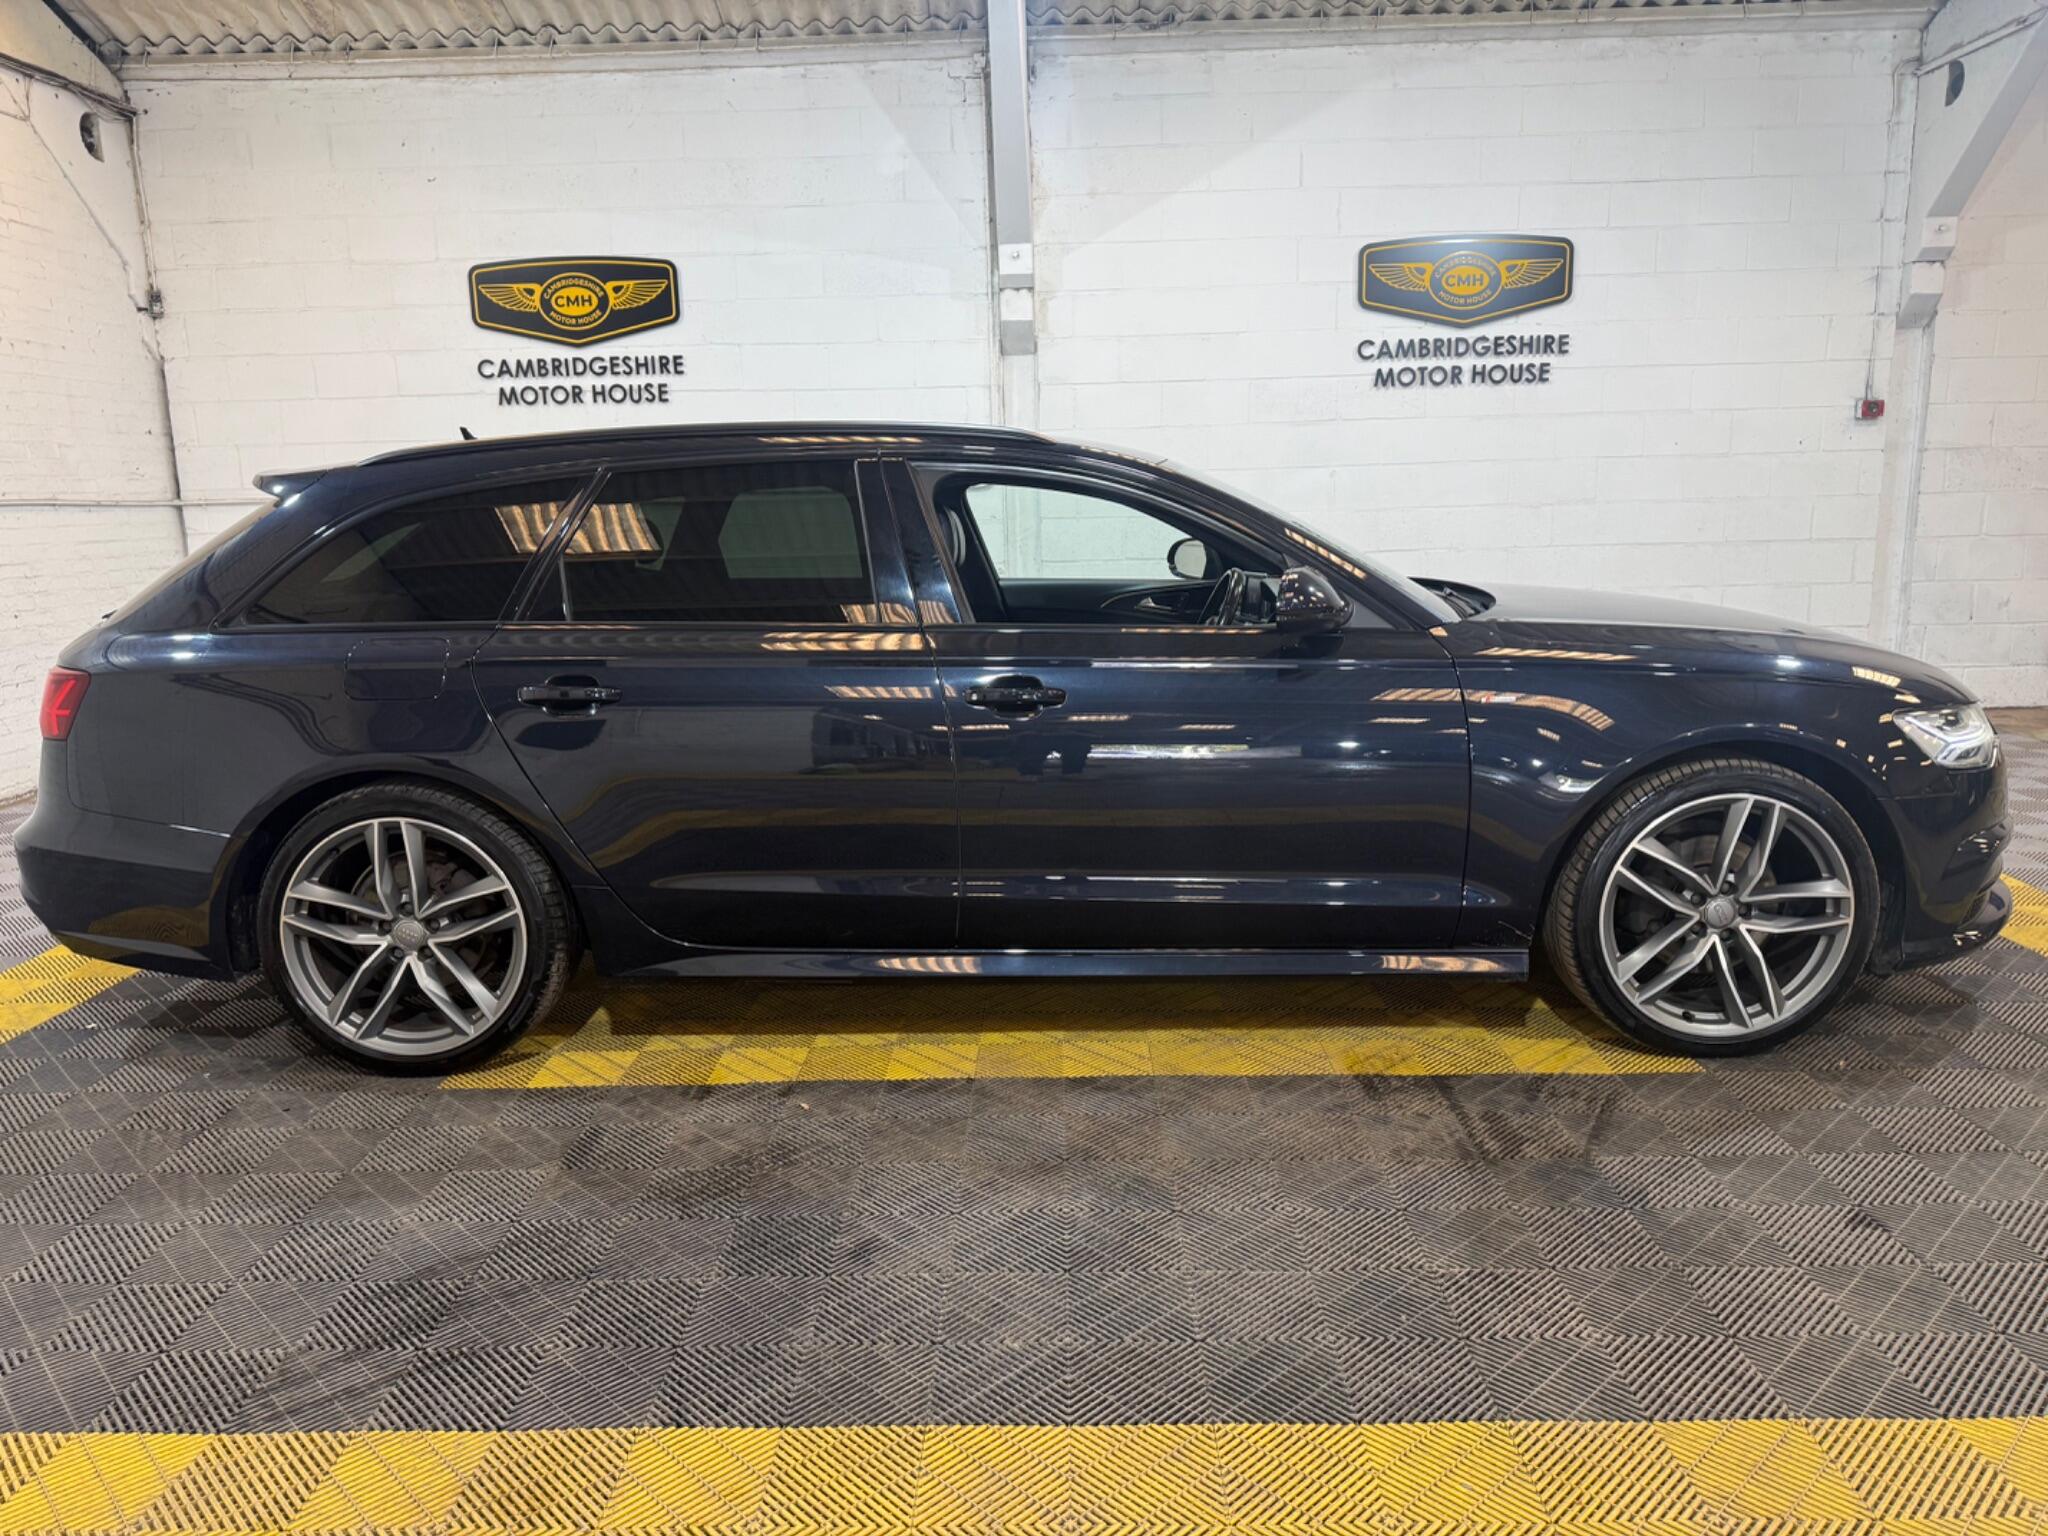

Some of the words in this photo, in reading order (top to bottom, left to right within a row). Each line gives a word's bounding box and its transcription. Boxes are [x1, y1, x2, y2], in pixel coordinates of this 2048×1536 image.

[1444, 273, 1484, 288] CMH
[554, 294, 593, 308] CMH
[550, 311, 577, 325] MOTOR
[577, 309, 602, 324] HOUSE
[1357, 334, 1570, 360] CAMBRIDGESHIRE
[477, 355, 685, 379] CAMBRIDGESHIRE
[1373, 366, 1463, 388] MOTOR
[1471, 363, 1551, 384] HOUSE
[498, 385, 585, 406] MOTOR
[592, 383, 670, 404] HOUSE
